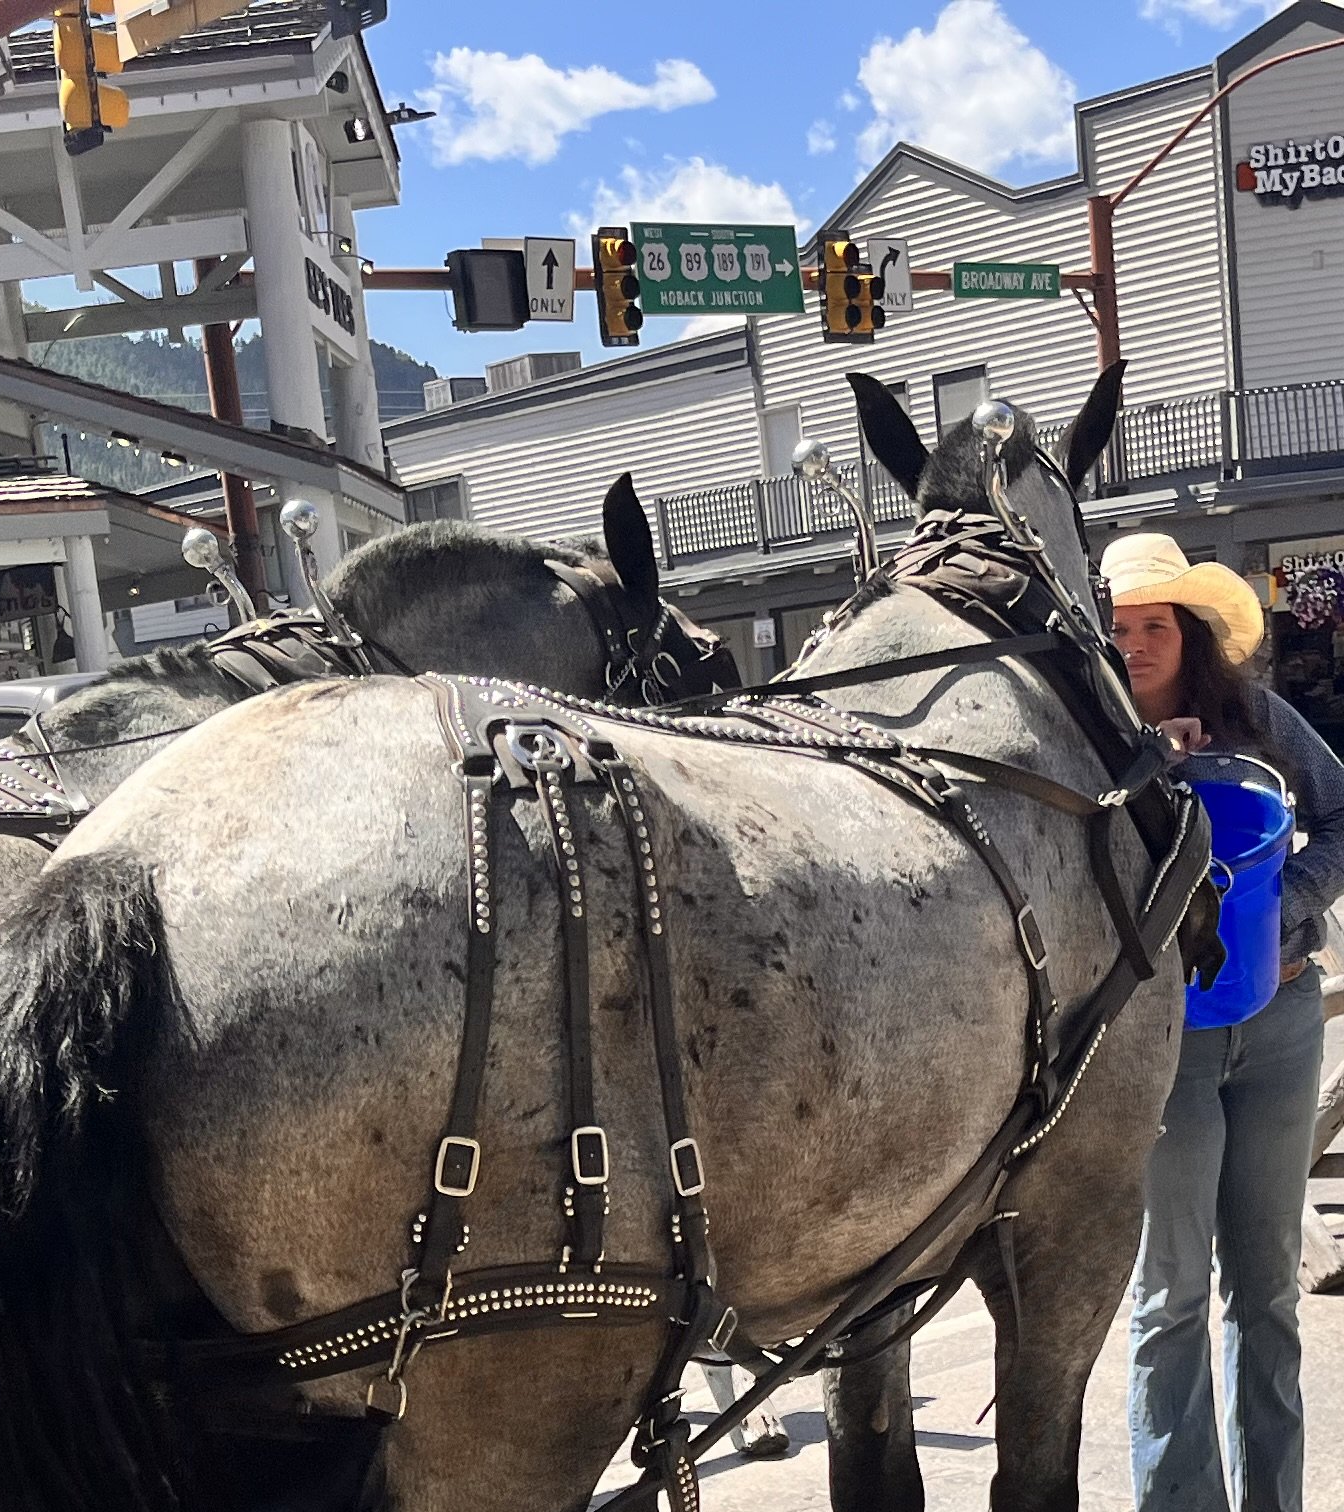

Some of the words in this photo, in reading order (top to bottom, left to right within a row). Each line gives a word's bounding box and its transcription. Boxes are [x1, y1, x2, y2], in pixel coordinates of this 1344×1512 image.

[648, 251, 665, 272] 26
[685, 251, 702, 272] 89
[716, 252, 735, 272] 189
[750, 253, 766, 272] 191
[961, 271, 1026, 291] BROADWAY
[1030, 273, 1053, 291] AVE
[530, 297, 566, 313] ONLY
[660, 291, 705, 306] HOBACK
[711, 290, 764, 306] JUNCTION
